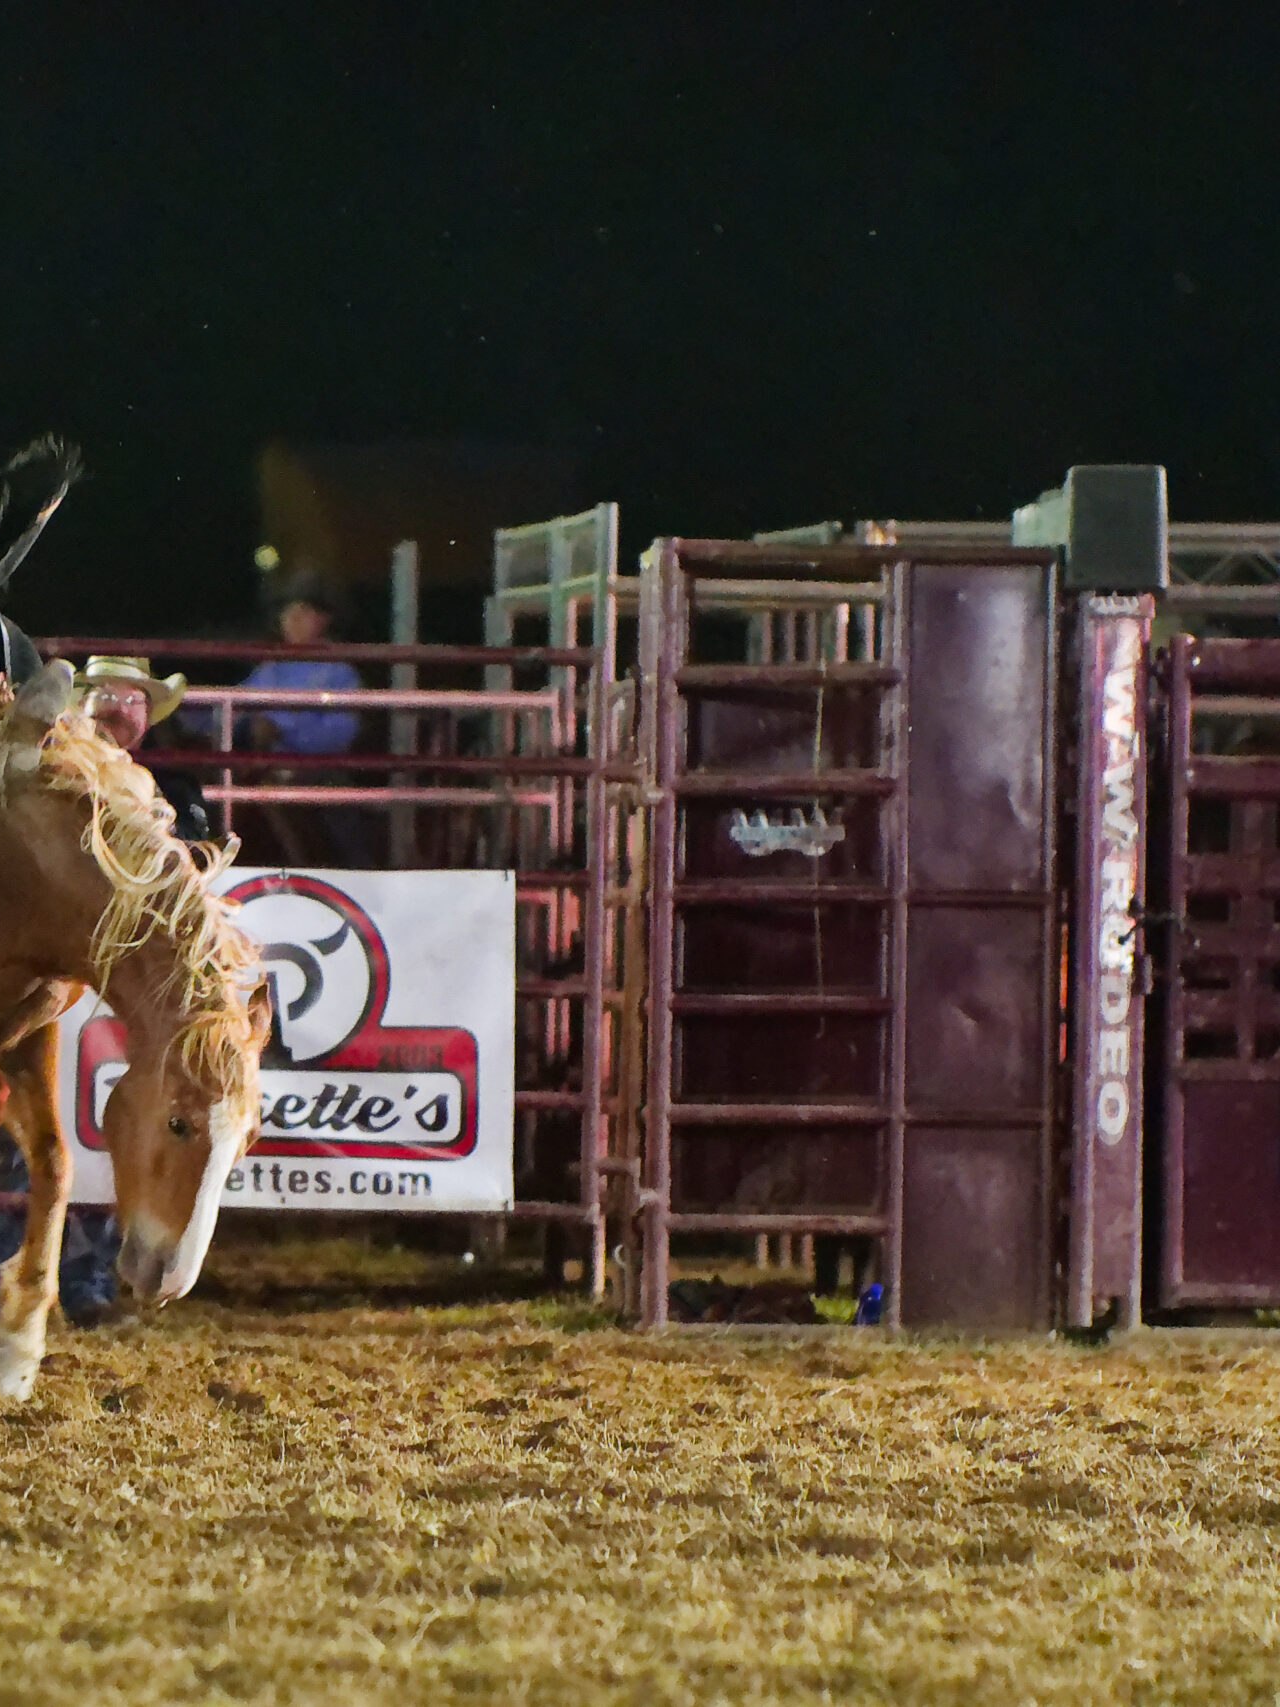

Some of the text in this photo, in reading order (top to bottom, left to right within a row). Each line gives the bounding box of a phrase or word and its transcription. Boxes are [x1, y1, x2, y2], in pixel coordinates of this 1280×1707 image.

[1097, 857, 1135, 1140] RODEO
[258, 1083, 450, 1132] ette's
[225, 1163, 432, 1196] ettes.com
